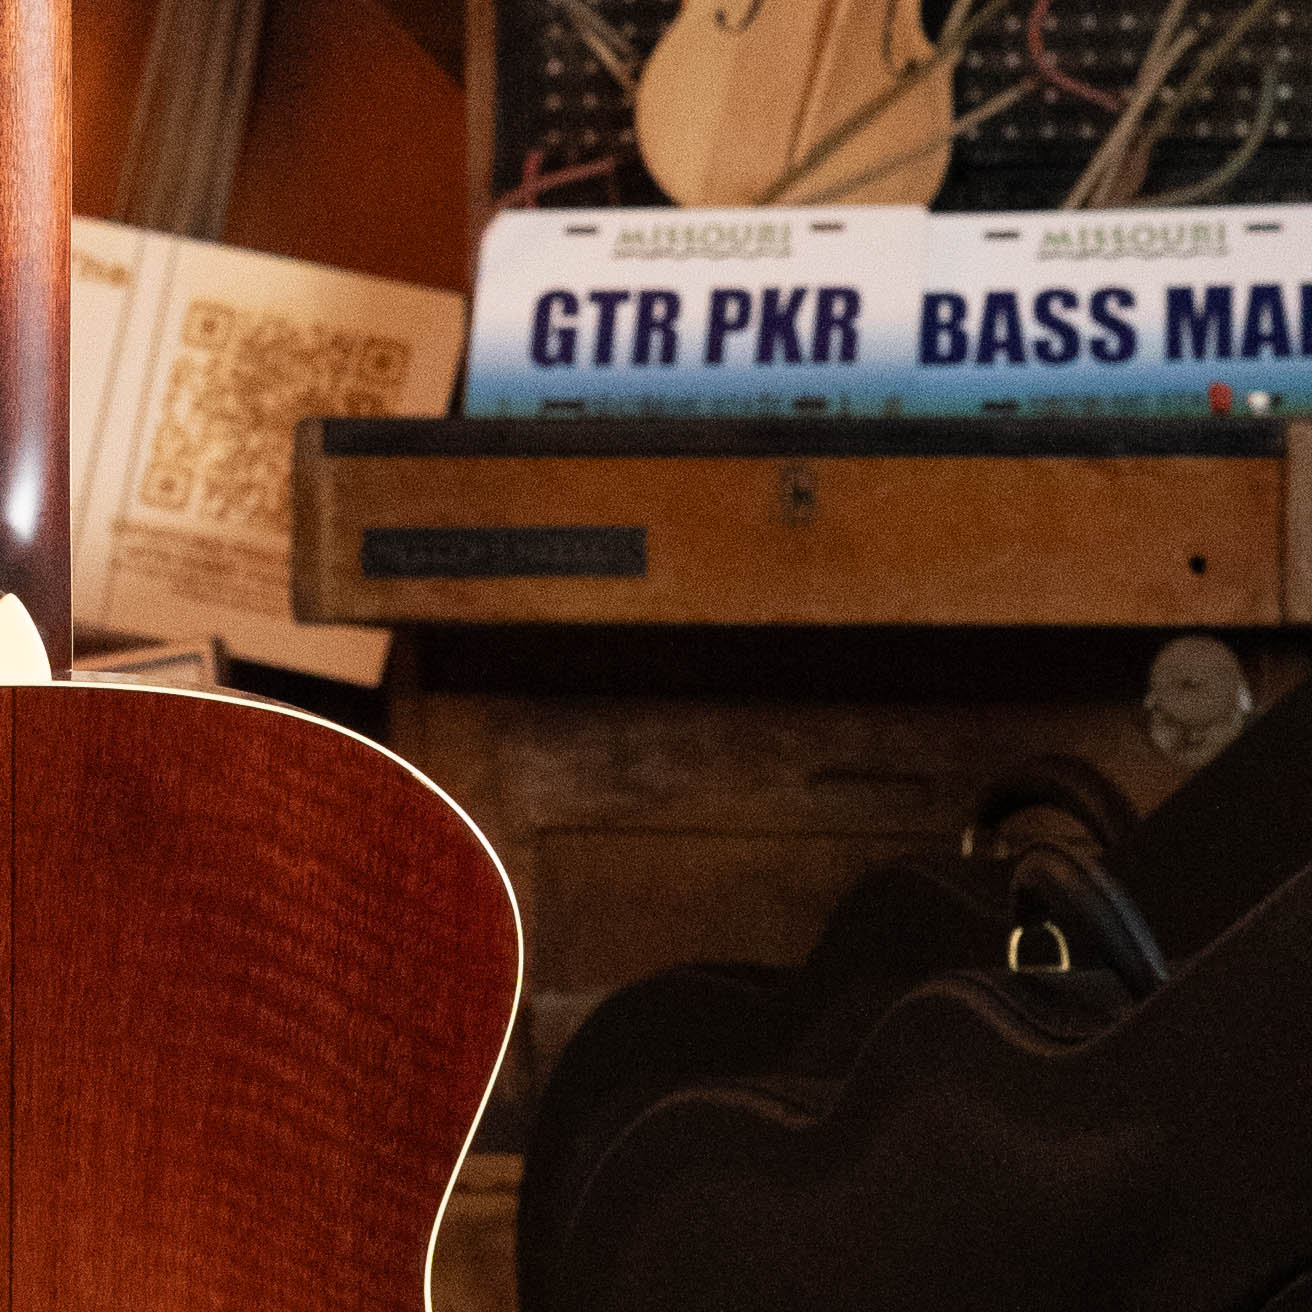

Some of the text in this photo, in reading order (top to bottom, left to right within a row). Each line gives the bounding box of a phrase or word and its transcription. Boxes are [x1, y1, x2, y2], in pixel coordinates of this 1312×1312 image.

[614, 222, 794, 249] MISSOURI
[1042, 222, 1229, 250] MISSOURI
[530, 284, 863, 370] GTR PKR
[918, 284, 1138, 368] BASS
